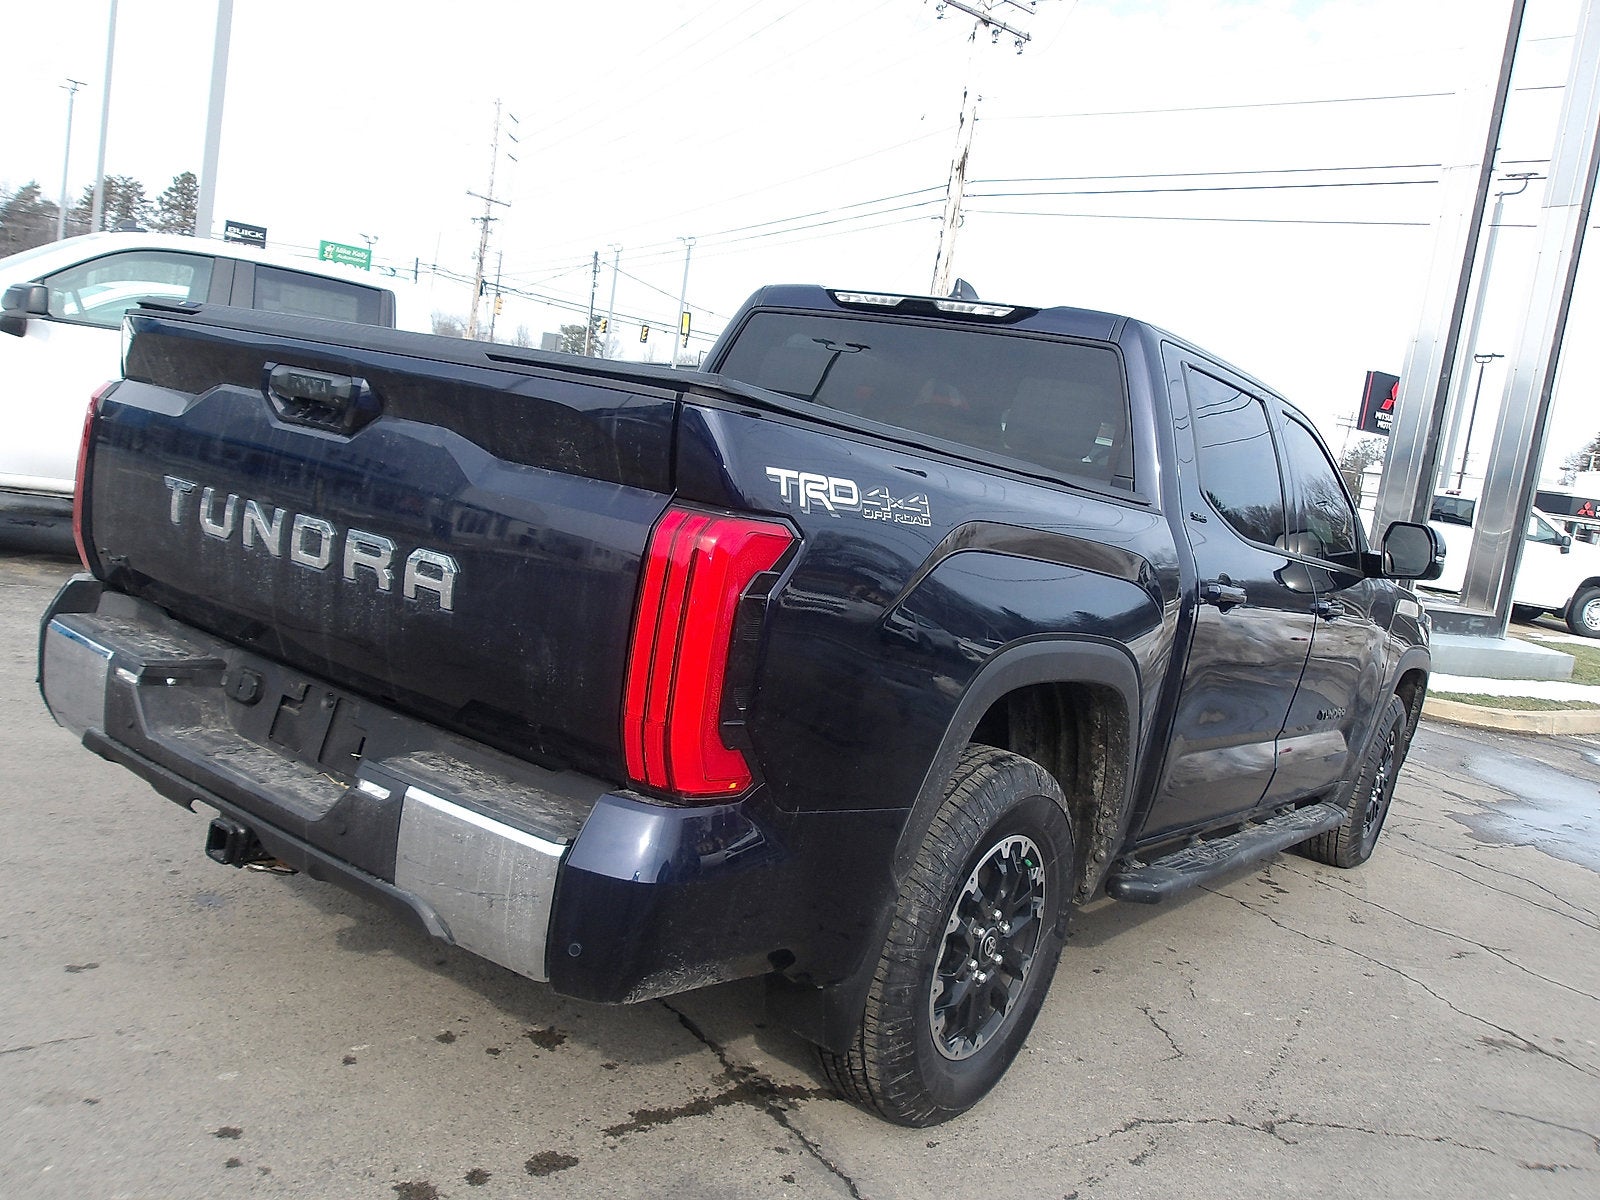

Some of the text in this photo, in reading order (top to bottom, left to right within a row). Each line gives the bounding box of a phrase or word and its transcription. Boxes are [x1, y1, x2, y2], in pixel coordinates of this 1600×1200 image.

[228, 226, 265, 239] BUICK
[351, 249, 368, 260] Kelly
[765, 466, 863, 518] TRD
[862, 508, 932, 527] OFF ROAD
[163, 474, 461, 612] TUNDRA
